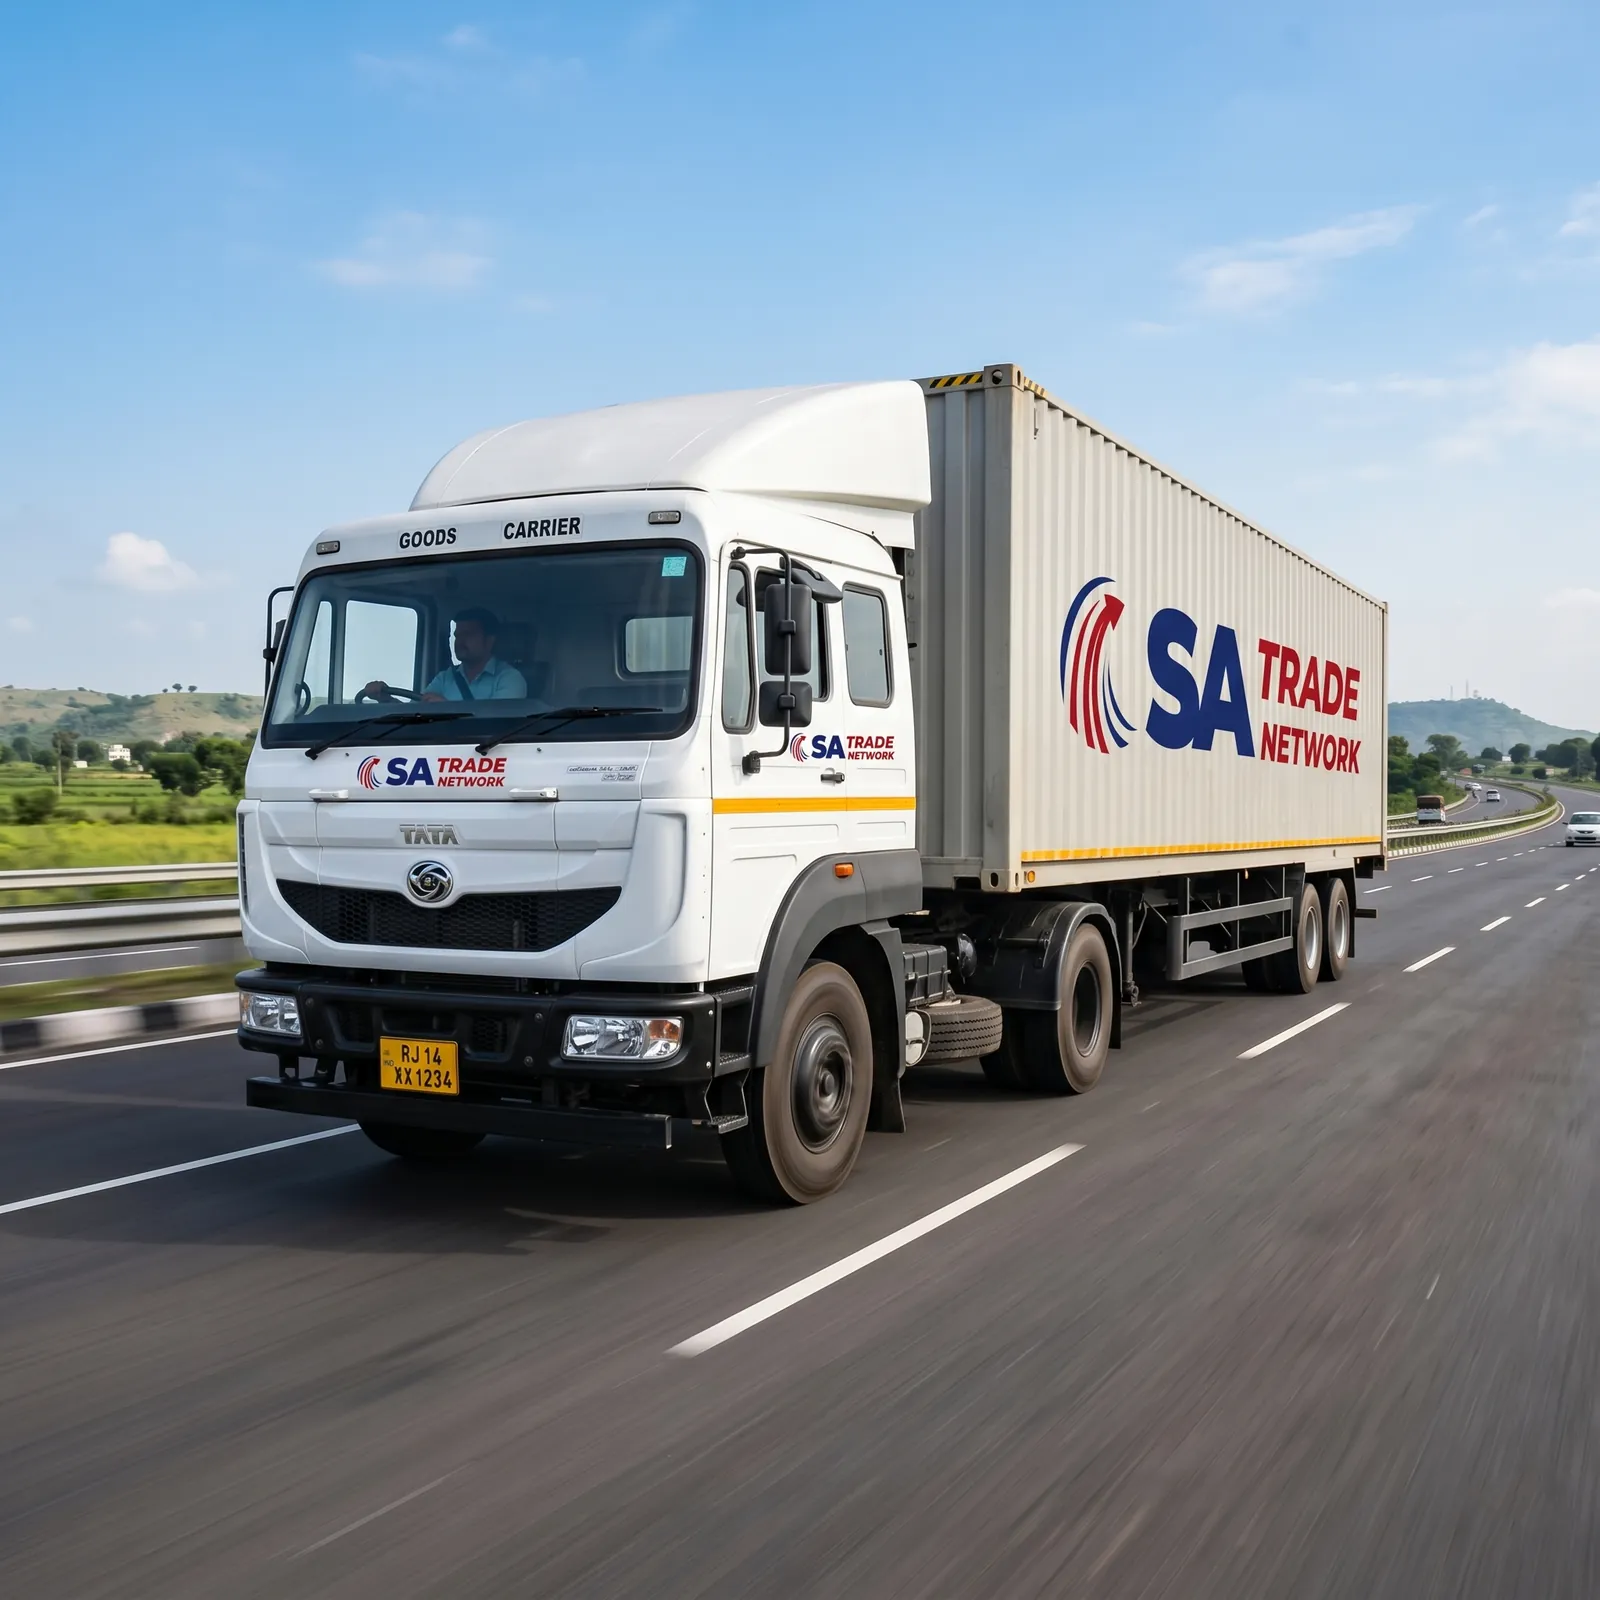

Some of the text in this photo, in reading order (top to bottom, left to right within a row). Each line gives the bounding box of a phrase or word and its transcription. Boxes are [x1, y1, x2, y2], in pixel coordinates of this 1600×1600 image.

[399, 516, 581, 549] GOODS CARRIER
[1145, 607, 1255, 757] SA
[1258, 638, 1361, 721] TRADE
[811, 734, 846, 760] SA
[846, 735, 895, 749] TRADE
[1260, 722, 1361, 774] NETWORK
[437, 757, 507, 773] TRADE
[847, 751, 895, 760] NETWORK
[386, 757, 434, 787] SA
[437, 776, 506, 787] NETWORK
[399, 824, 460, 845] TATA
[401, 1044, 442, 1066] RJ 14
